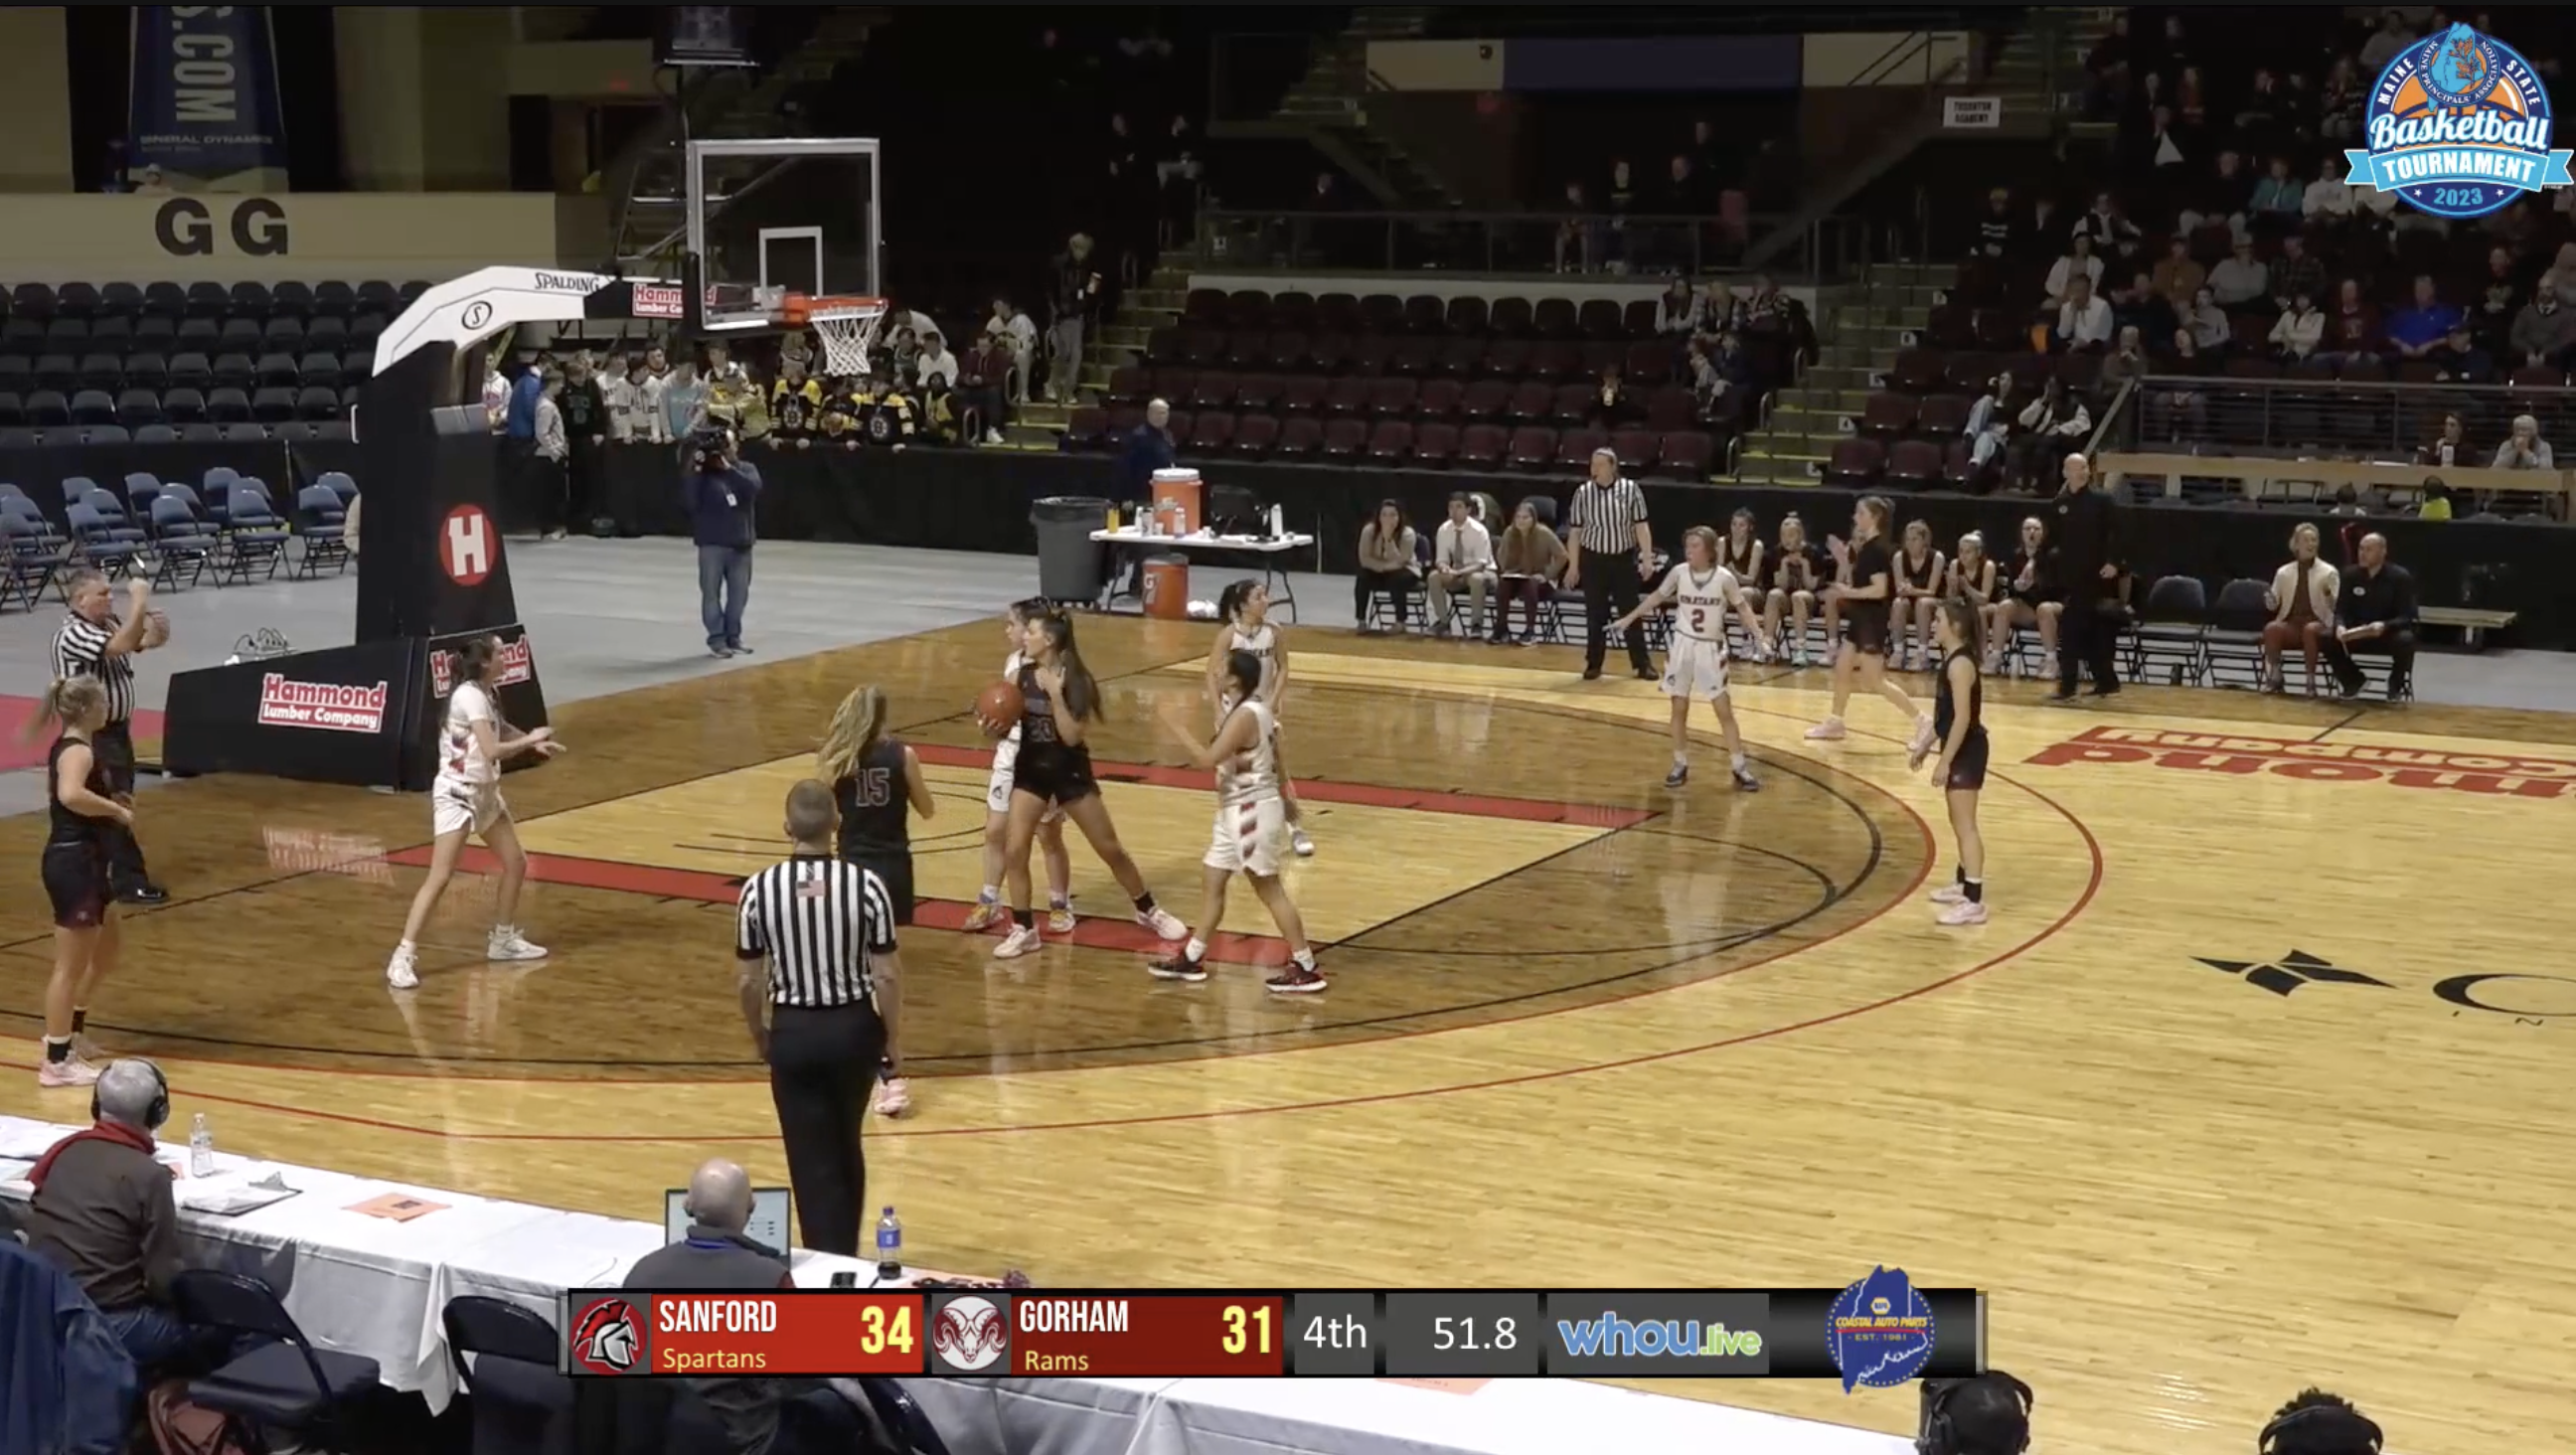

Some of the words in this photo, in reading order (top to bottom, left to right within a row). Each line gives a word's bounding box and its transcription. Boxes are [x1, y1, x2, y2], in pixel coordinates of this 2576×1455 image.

[535, 272, 599, 292] SPALDING
[449, 514, 487, 576] H
[1690, 608, 1705, 633] 2
[263, 673, 388, 709] Hammond
[264, 705, 311, 722] Lumber
[315, 708, 378, 728] Company
[854, 767, 890, 807] 15
[2020, 742, 2576, 799] mond
